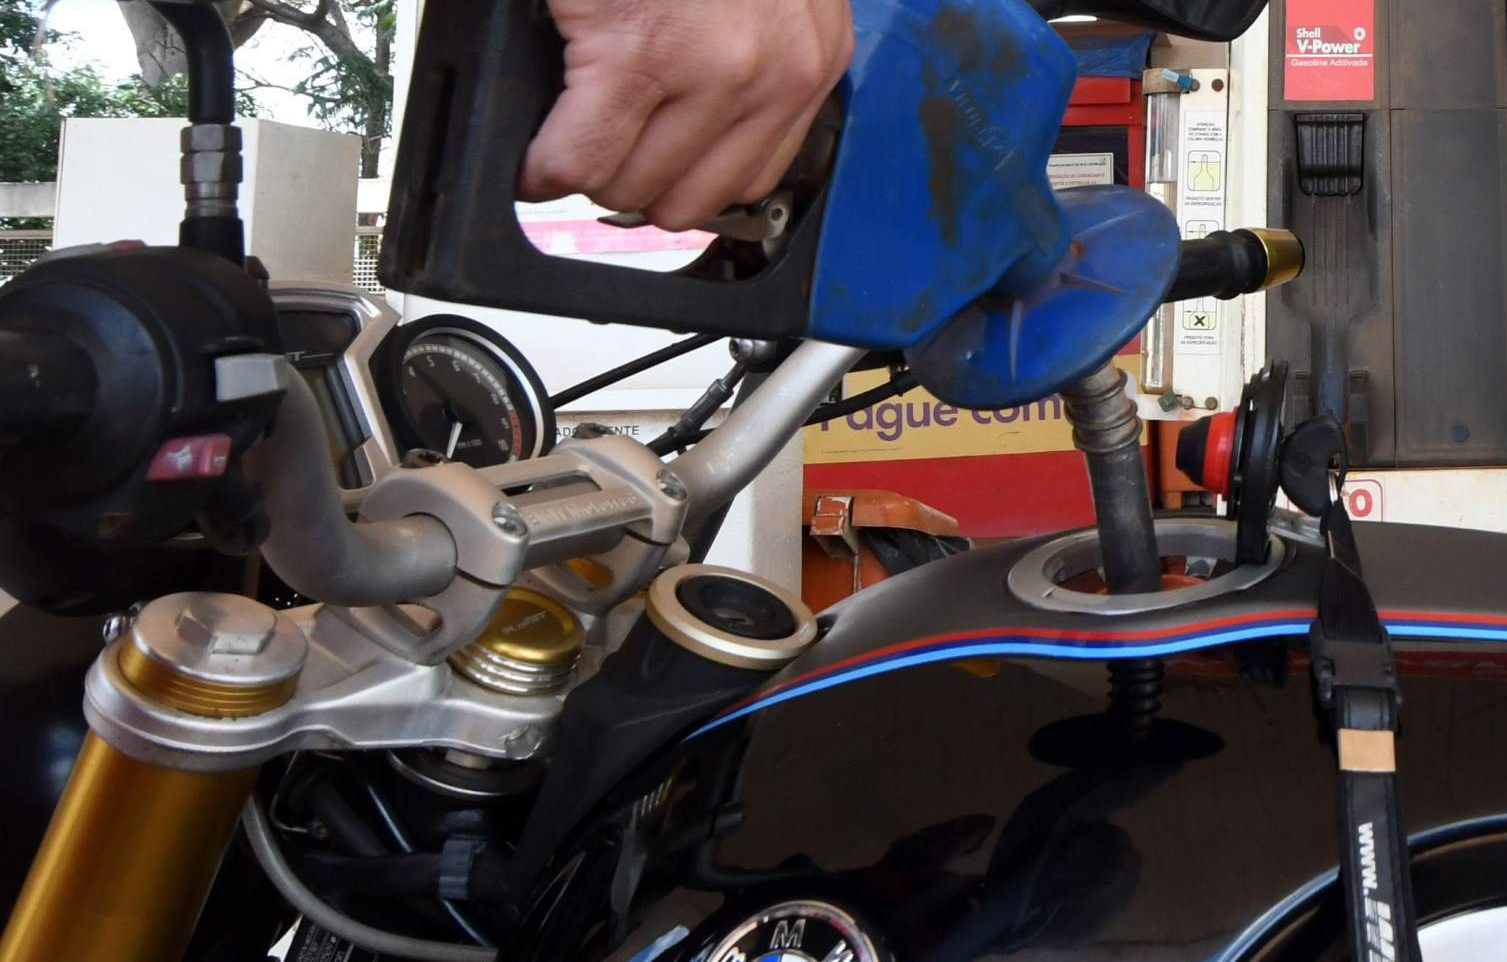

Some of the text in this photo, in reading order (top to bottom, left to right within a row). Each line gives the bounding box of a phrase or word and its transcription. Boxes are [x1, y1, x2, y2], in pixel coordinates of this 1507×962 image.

[1296, 26, 1321, 39] Shell
[1296, 39, 1361, 54] V-Power
[1291, 58, 1368, 67] Gasolina Aditivada
